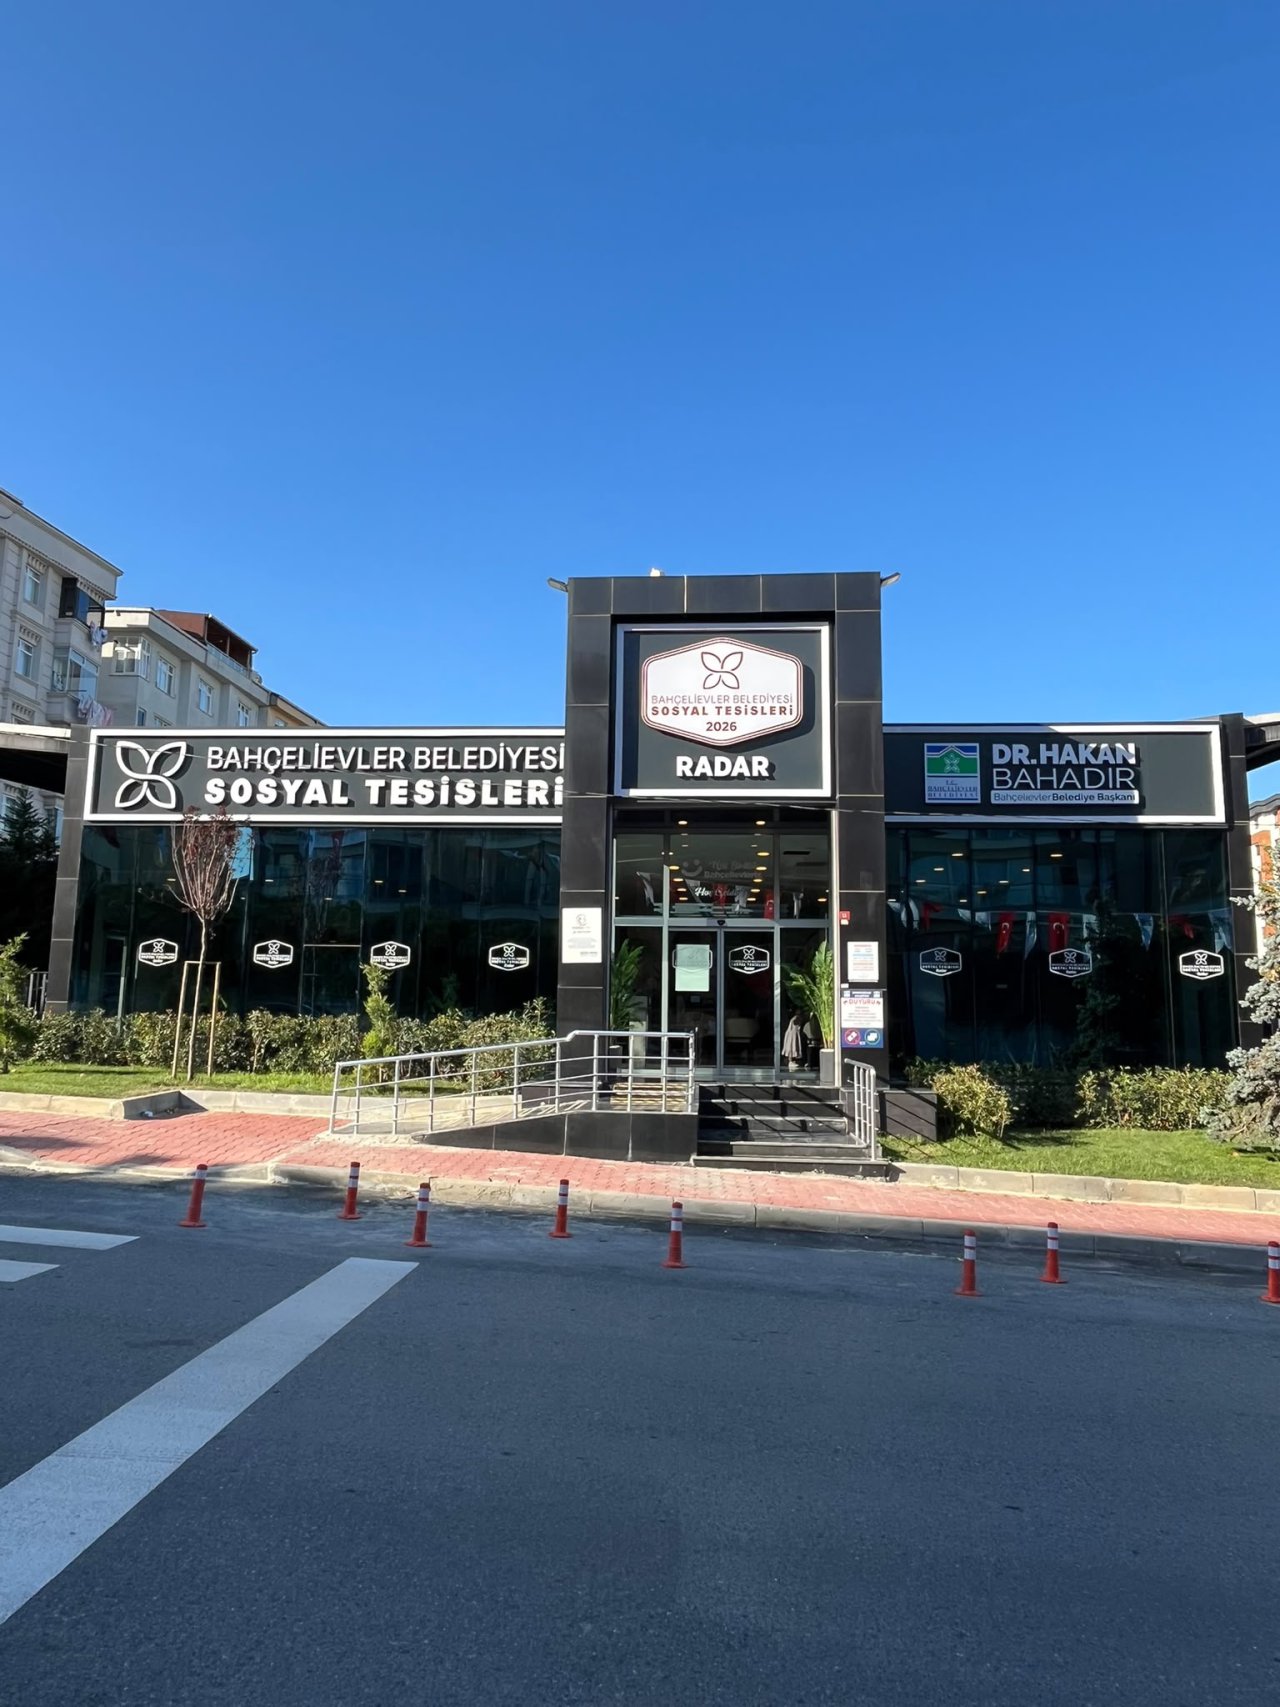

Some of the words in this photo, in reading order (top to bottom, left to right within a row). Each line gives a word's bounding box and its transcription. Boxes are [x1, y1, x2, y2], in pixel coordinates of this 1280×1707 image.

[651, 693, 730, 706] BAHÇELİEVLER
[732, 693, 793, 704] BELEDİYESİ
[651, 705, 709, 716] SOSYAL
[714, 704, 793, 716] TESİSLERİ
[705, 721, 737, 732] 2026
[206, 743, 406, 775] BAHÇELİEVLER
[412, 742, 566, 771] BELEDİYESİ
[675, 755, 770, 778] RADAR
[992, 766, 1137, 790] BAHADIR
[203, 778, 349, 806] SOSYAL
[364, 775, 565, 806] TESİSLERİ
[1052, 792, 1096, 803] Belediye
